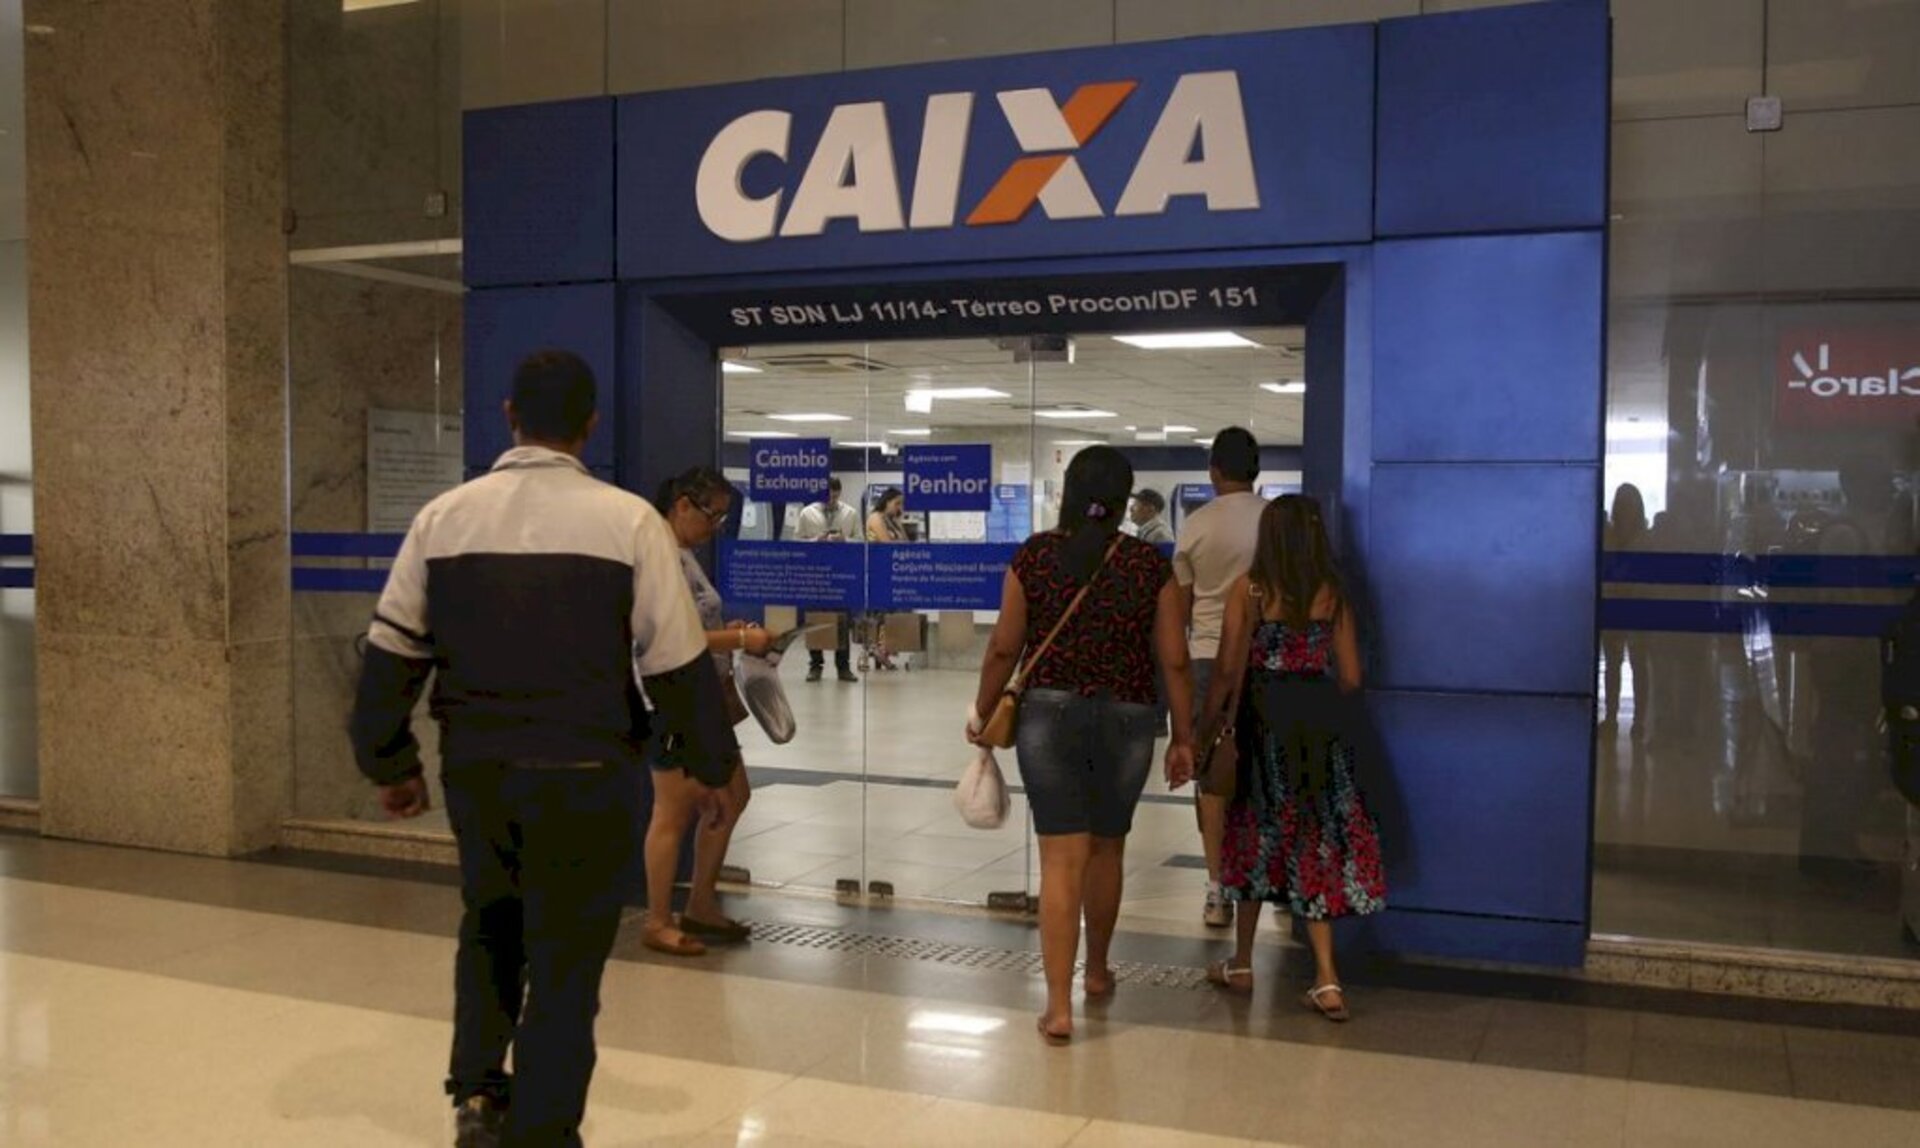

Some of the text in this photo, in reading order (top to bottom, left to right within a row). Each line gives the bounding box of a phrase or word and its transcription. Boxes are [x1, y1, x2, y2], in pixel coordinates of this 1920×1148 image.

[695, 70, 1261, 243] CAIXA
[730, 286, 1259, 326] ST SDN LJ 11/14- Térreo Procon/DF 151
[755, 449, 828, 468] Câmbio
[755, 474, 828, 491] Exchange
[907, 472, 988, 494] Penhor
[892, 549, 931, 561] Agência
[892, 562, 933, 573] Conjunto
[935, 562, 977, 573] Nacional
